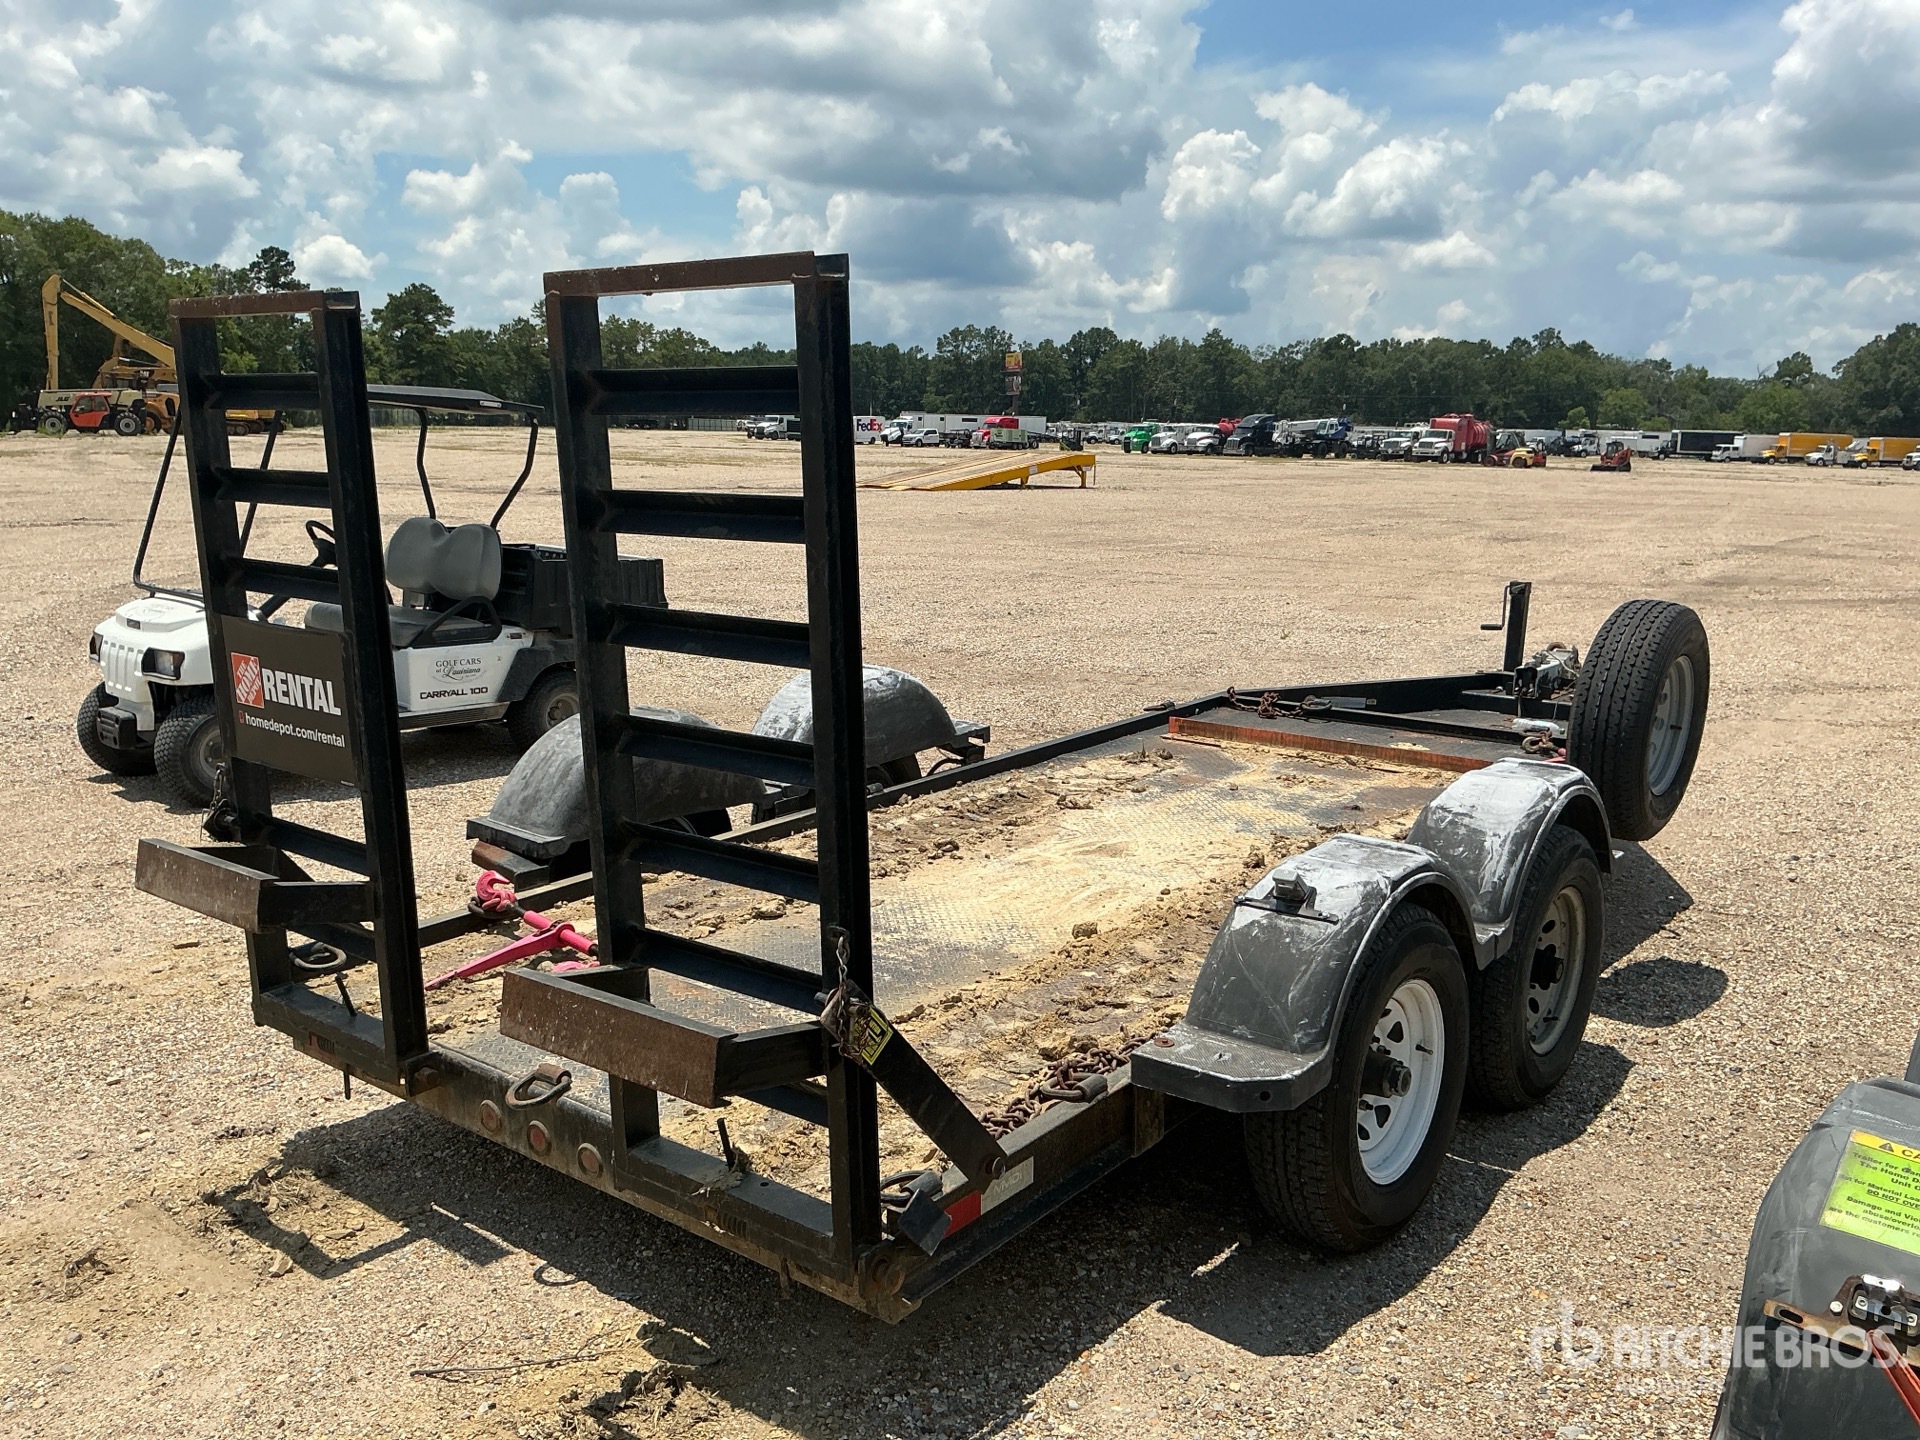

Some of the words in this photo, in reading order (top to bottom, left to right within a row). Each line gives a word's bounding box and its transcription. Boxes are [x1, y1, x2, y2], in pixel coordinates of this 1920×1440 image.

[856, 418, 883, 431] FedEx
[435, 660, 458, 668] GOLF
[459, 657, 482, 667] CARS
[236, 657, 259, 703] HOME
[442, 665, 482, 681] Louisiana
[247, 676, 262, 704] DEPOT
[261, 667, 342, 716] RENTAL
[420, 688, 468, 700] CARRYALL
[469, 686, 489, 695] 100
[244, 711, 346, 748] homedepot.com/rental
[1852, 1151, 1883, 1165] Trailer
[1885, 1162, 1899, 1171] for
[1860, 1160, 1878, 1170] The
[1880, 1167, 1910, 1181] Home
[1854, 1178, 1867, 1186] for
[1867, 1182, 1902, 1198] Material
[1891, 1177, 1911, 1188] Unit
[1866, 1188, 1880, 1197] DO
[1881, 1193, 1901, 1203] NOT
[1846, 1196, 1883, 1211] Damage
[1884, 1208, 1902, 1217] and
[1828, 1206, 1844, 1214] are
[1845, 1210, 1860, 1218] the
[1861, 1216, 1910, 1234] customers
